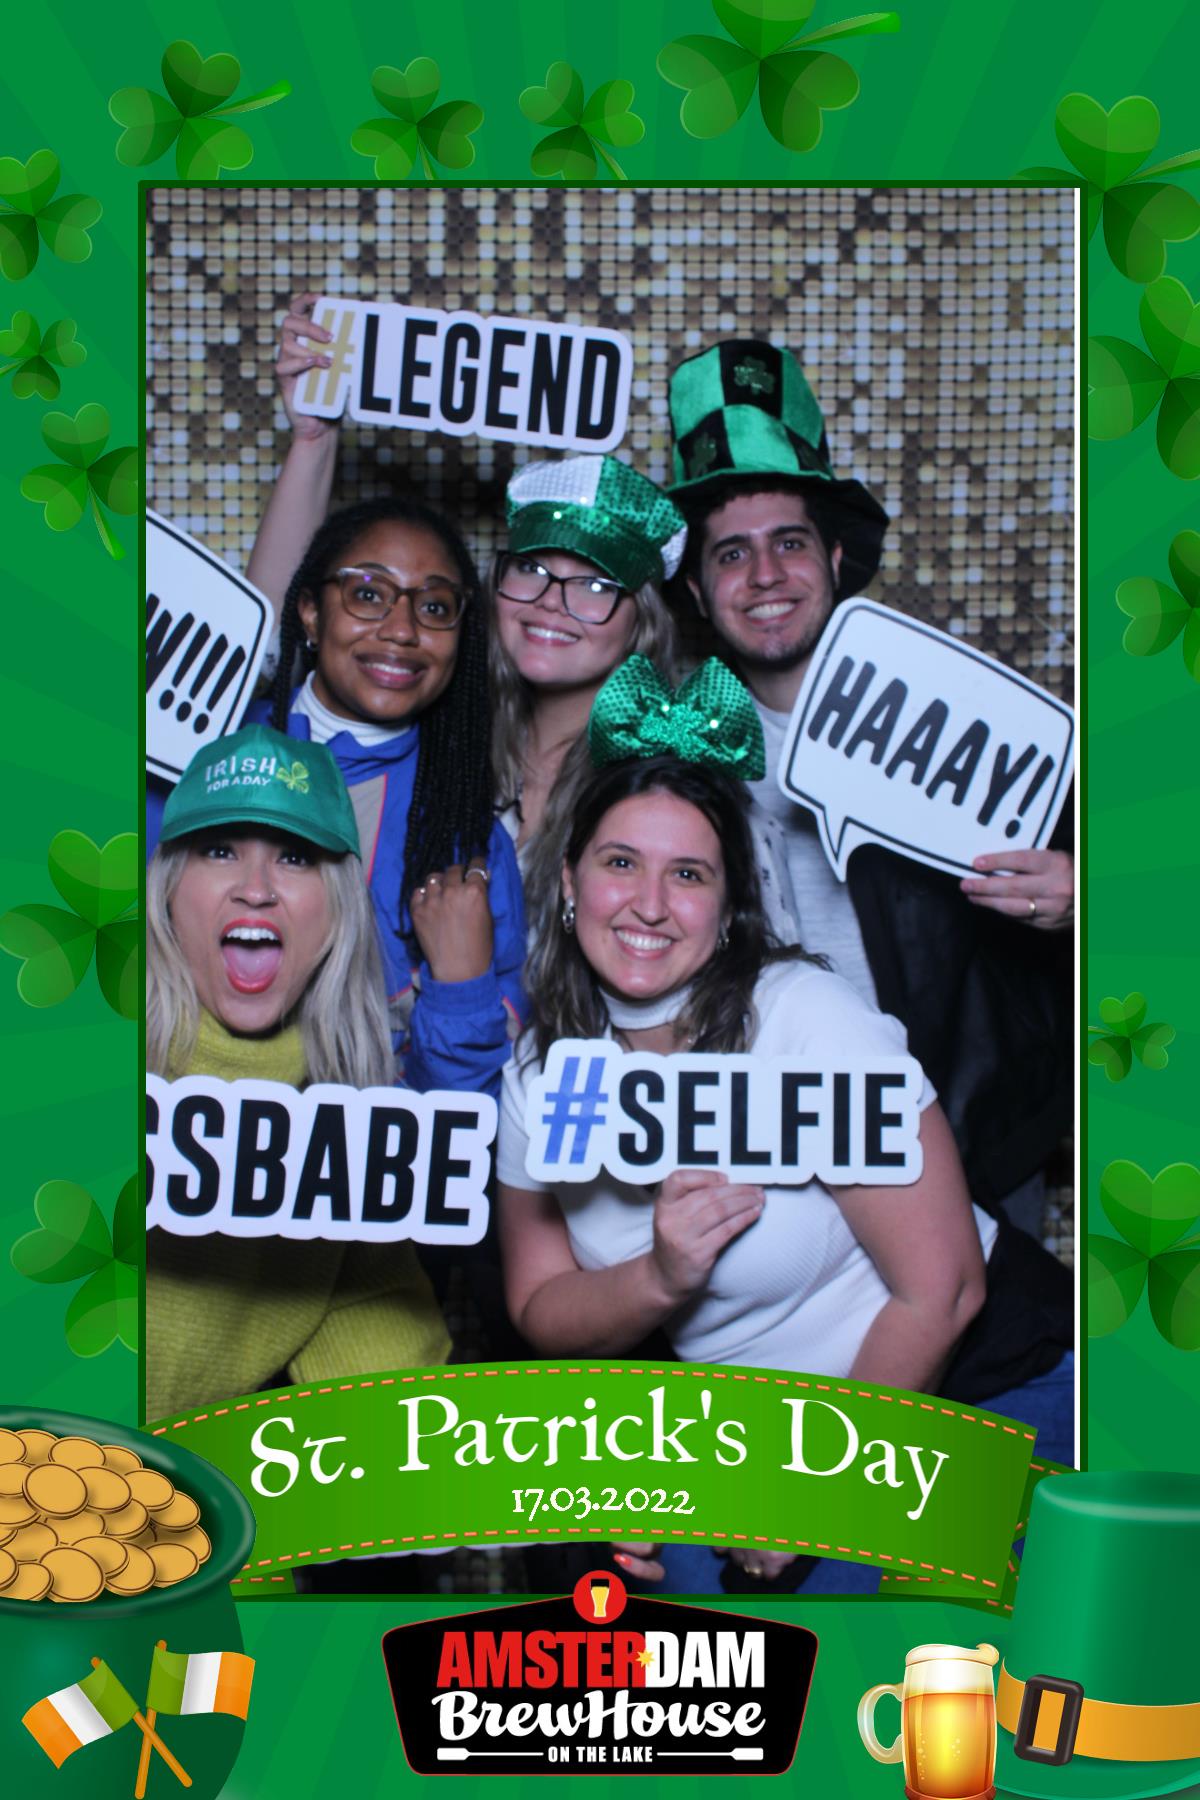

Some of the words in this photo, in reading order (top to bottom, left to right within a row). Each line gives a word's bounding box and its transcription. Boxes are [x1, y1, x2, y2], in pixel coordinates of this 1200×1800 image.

[303, 308, 622, 442] #LEGEND
[205, 755, 277, 782] IRISH
[207, 779, 230, 793] FOR
[231, 776, 241, 786] A
[242, 775, 271, 787] DAY
[808, 655, 1055, 839] HAAAY!
[146, 1093, 479, 1227] SBABE
[543, 1057, 906, 1167] #SELFIE
